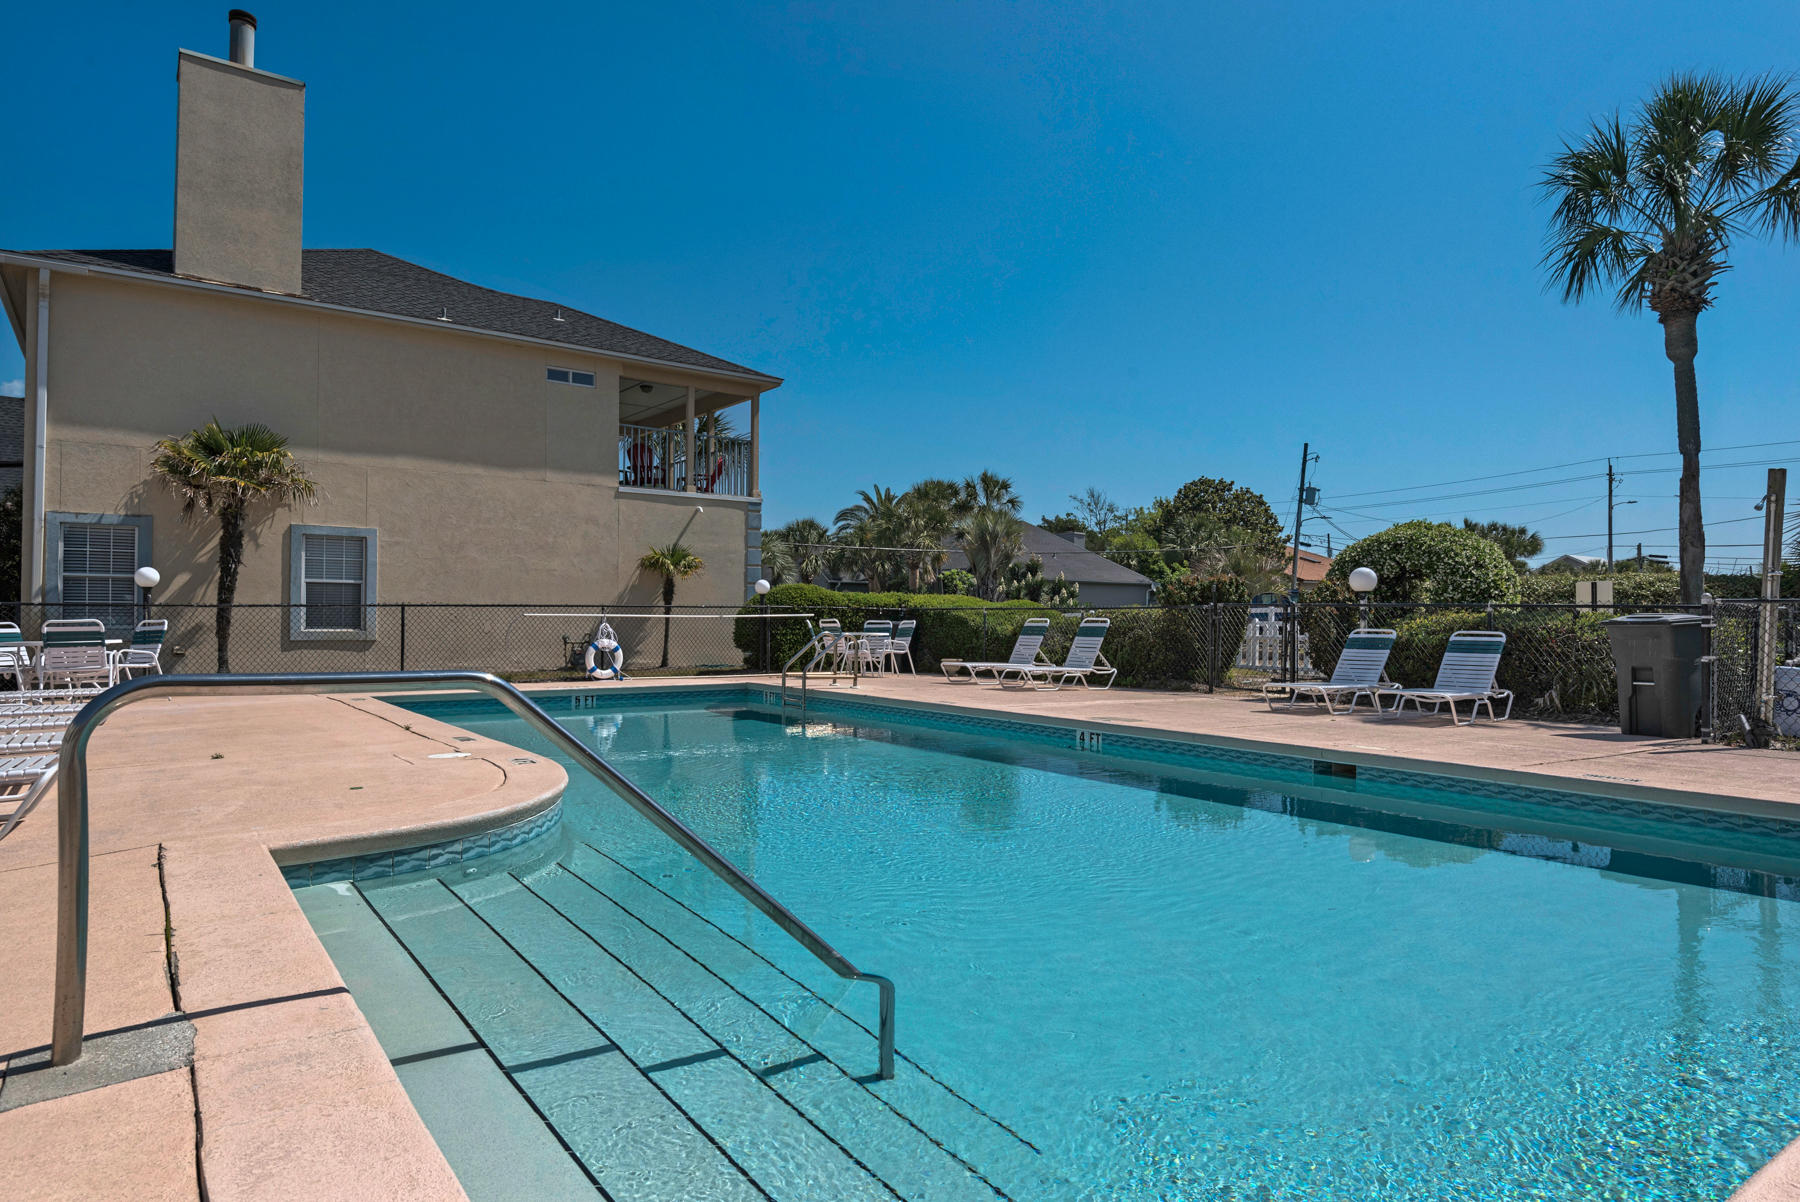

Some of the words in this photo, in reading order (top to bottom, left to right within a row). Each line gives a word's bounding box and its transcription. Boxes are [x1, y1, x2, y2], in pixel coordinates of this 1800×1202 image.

[584, 695, 594, 705] FT
[1079, 731, 1085, 742] 4
[1089, 732, 1101, 744] FT
